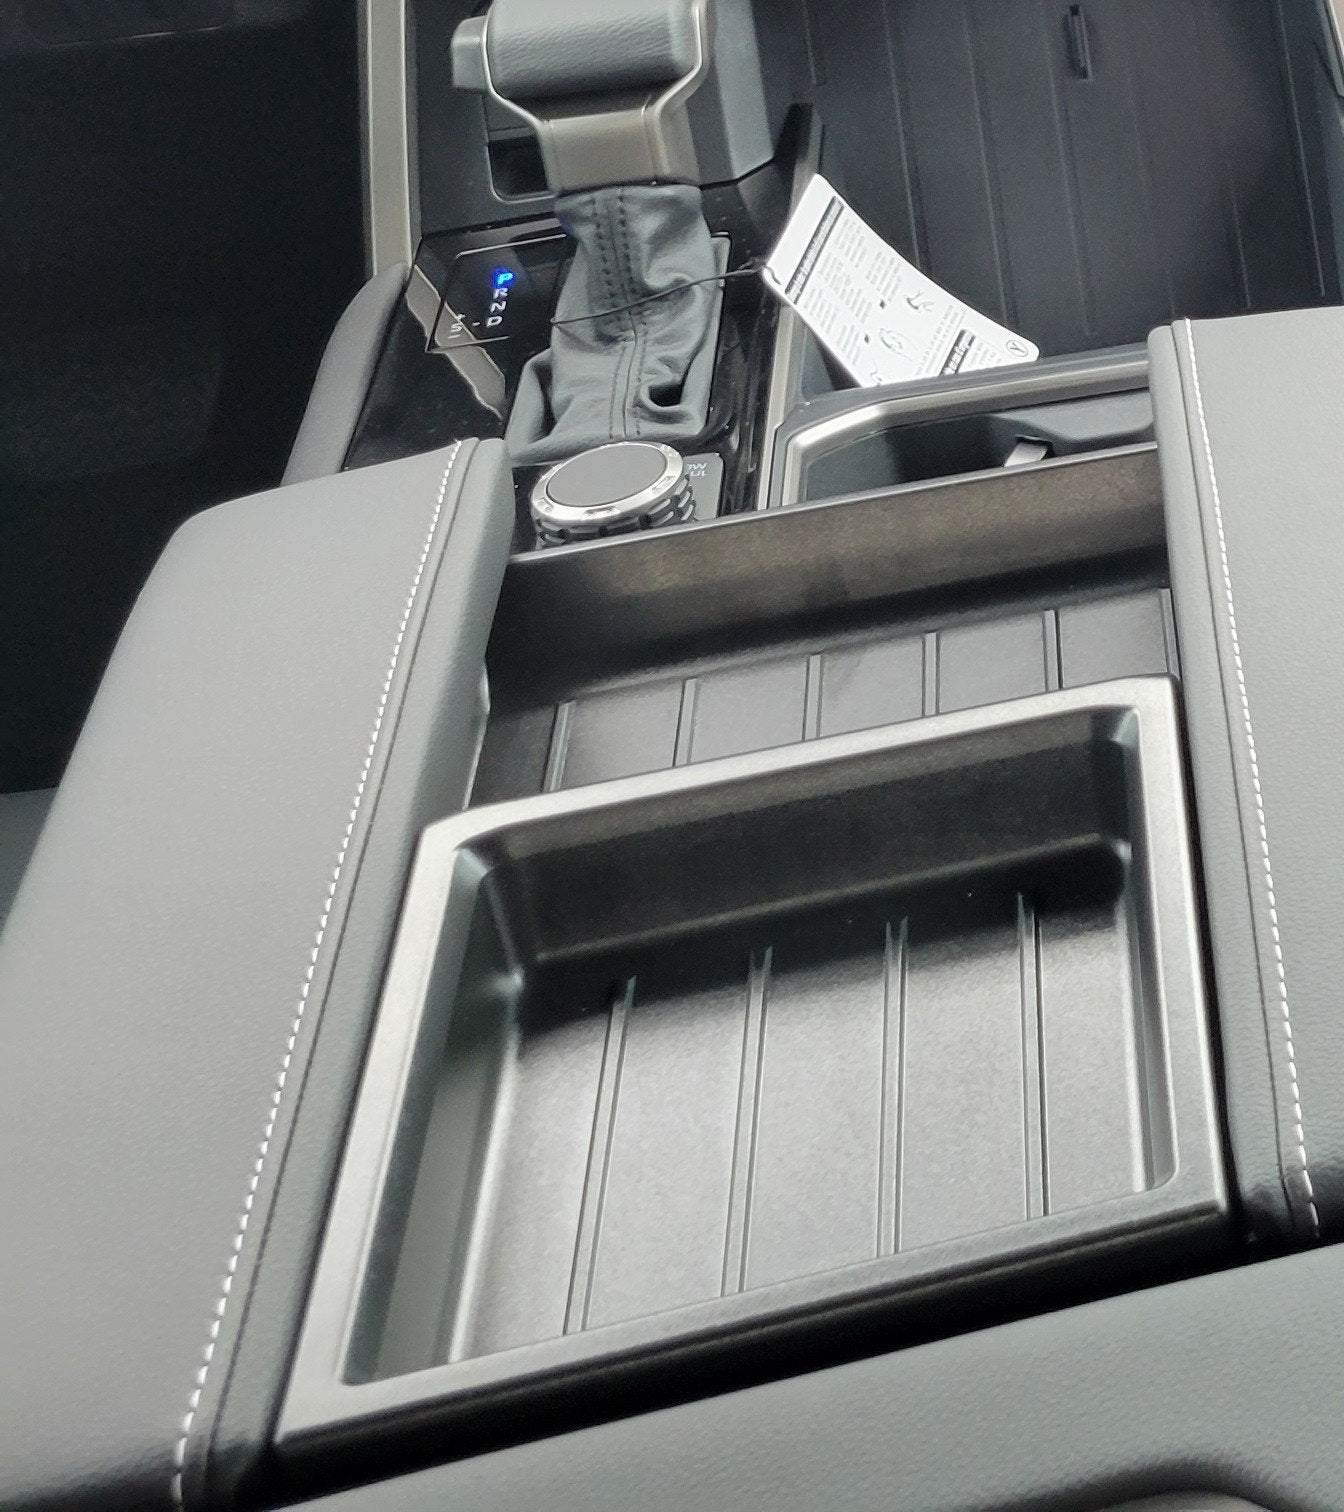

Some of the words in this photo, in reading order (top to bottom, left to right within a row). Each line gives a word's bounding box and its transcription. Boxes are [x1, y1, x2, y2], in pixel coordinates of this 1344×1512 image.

[496, 272, 514, 285] P
[492, 287, 509, 299] R
[490, 300, 508, 312] N
[486, 316, 503, 328] D
